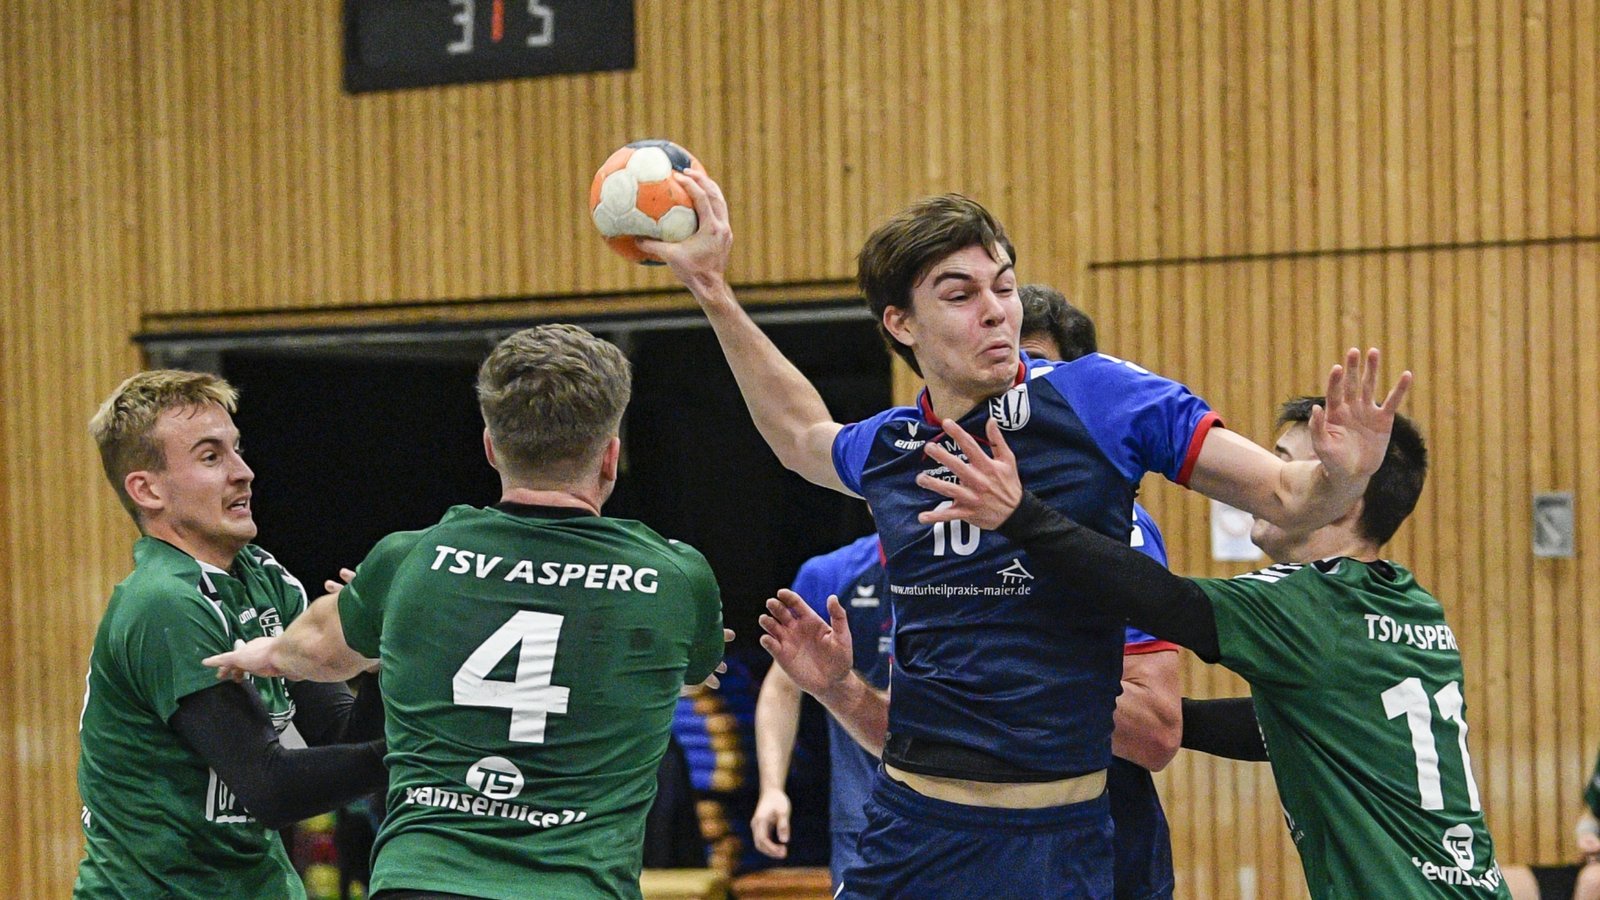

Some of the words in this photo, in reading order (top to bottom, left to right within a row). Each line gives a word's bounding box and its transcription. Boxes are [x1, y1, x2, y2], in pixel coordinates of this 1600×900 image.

[933, 500, 981, 556] 10
[430, 545, 503, 579] TSV
[504, 559, 658, 594] ASPERG
[1364, 613, 1402, 643] TSV
[1404, 623, 1459, 651] ASPER
[452, 609, 571, 743] 4
[1380, 676, 1481, 812] 11
